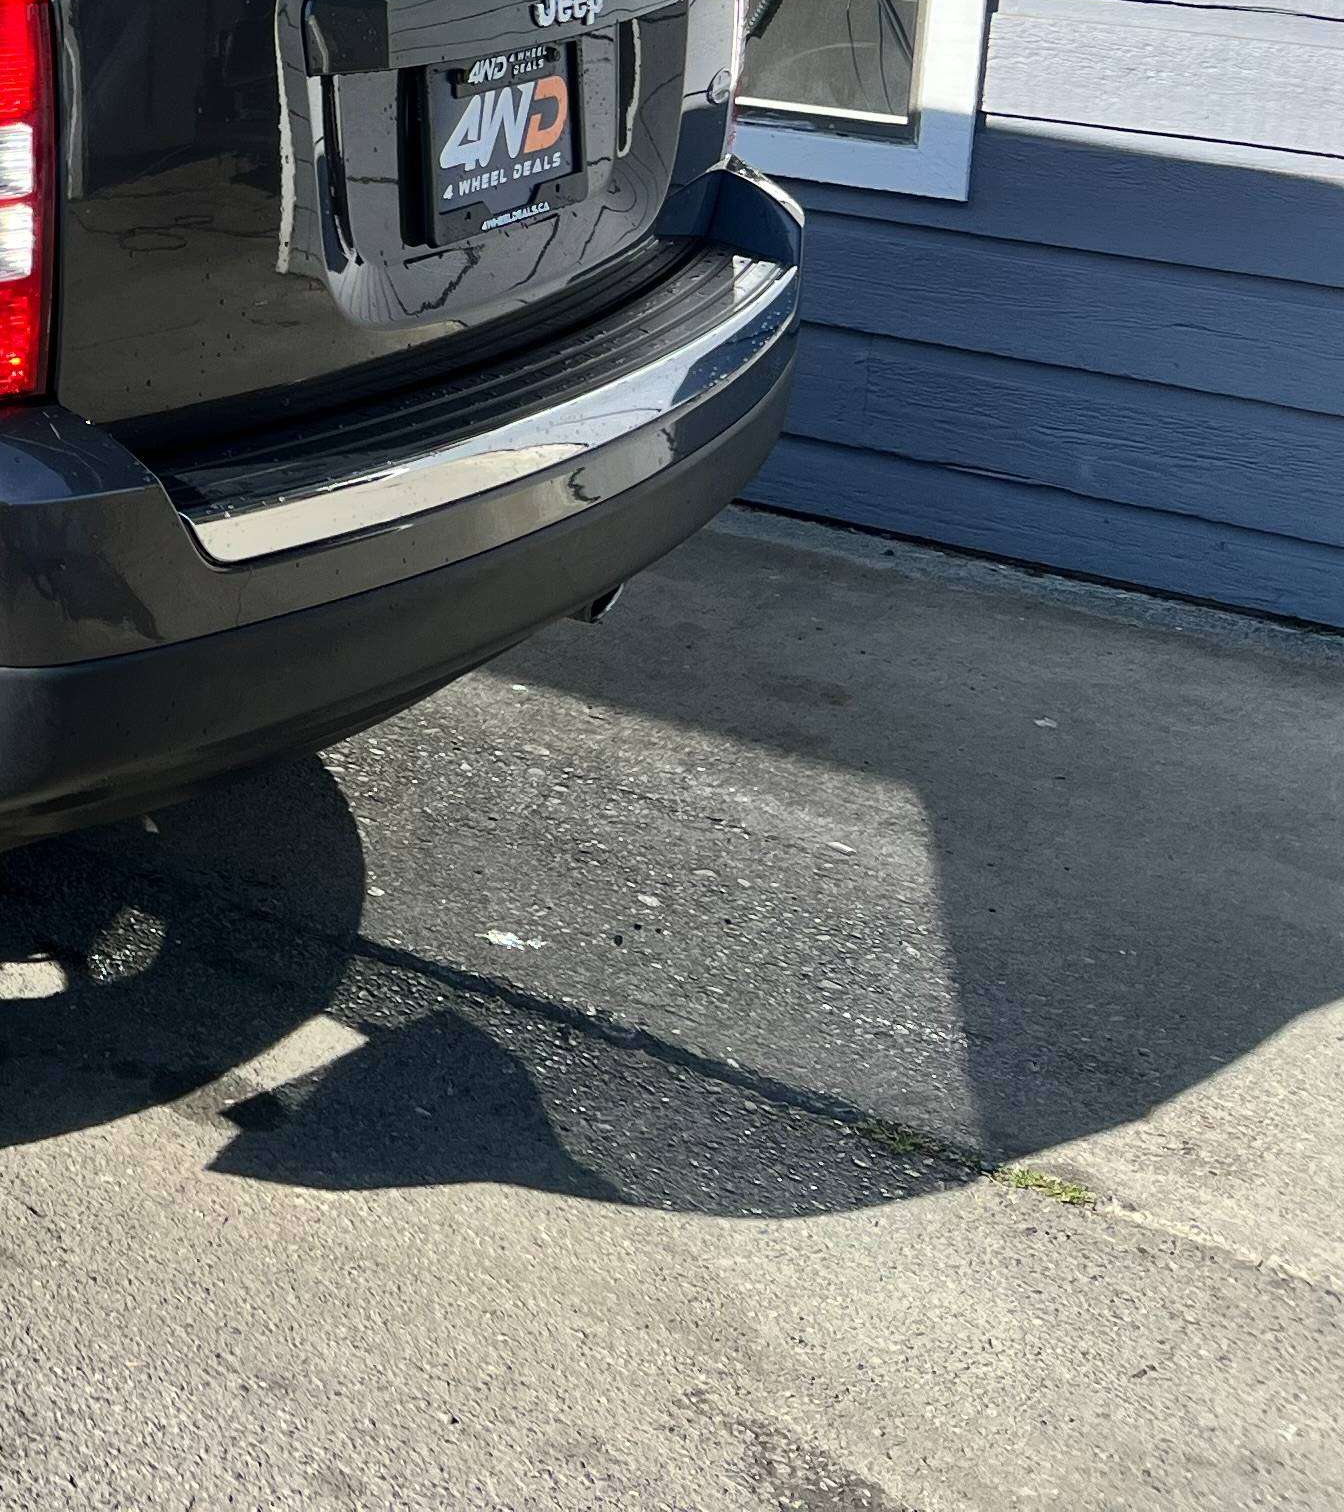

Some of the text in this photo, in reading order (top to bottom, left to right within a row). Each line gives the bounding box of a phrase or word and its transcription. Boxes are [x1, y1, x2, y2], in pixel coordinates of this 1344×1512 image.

[467, 55, 508, 84] 4WD
[513, 58, 545, 75] DEALS
[439, 75, 568, 172] 4WD
[443, 151, 562, 200] 4 WHEEL DEALS
